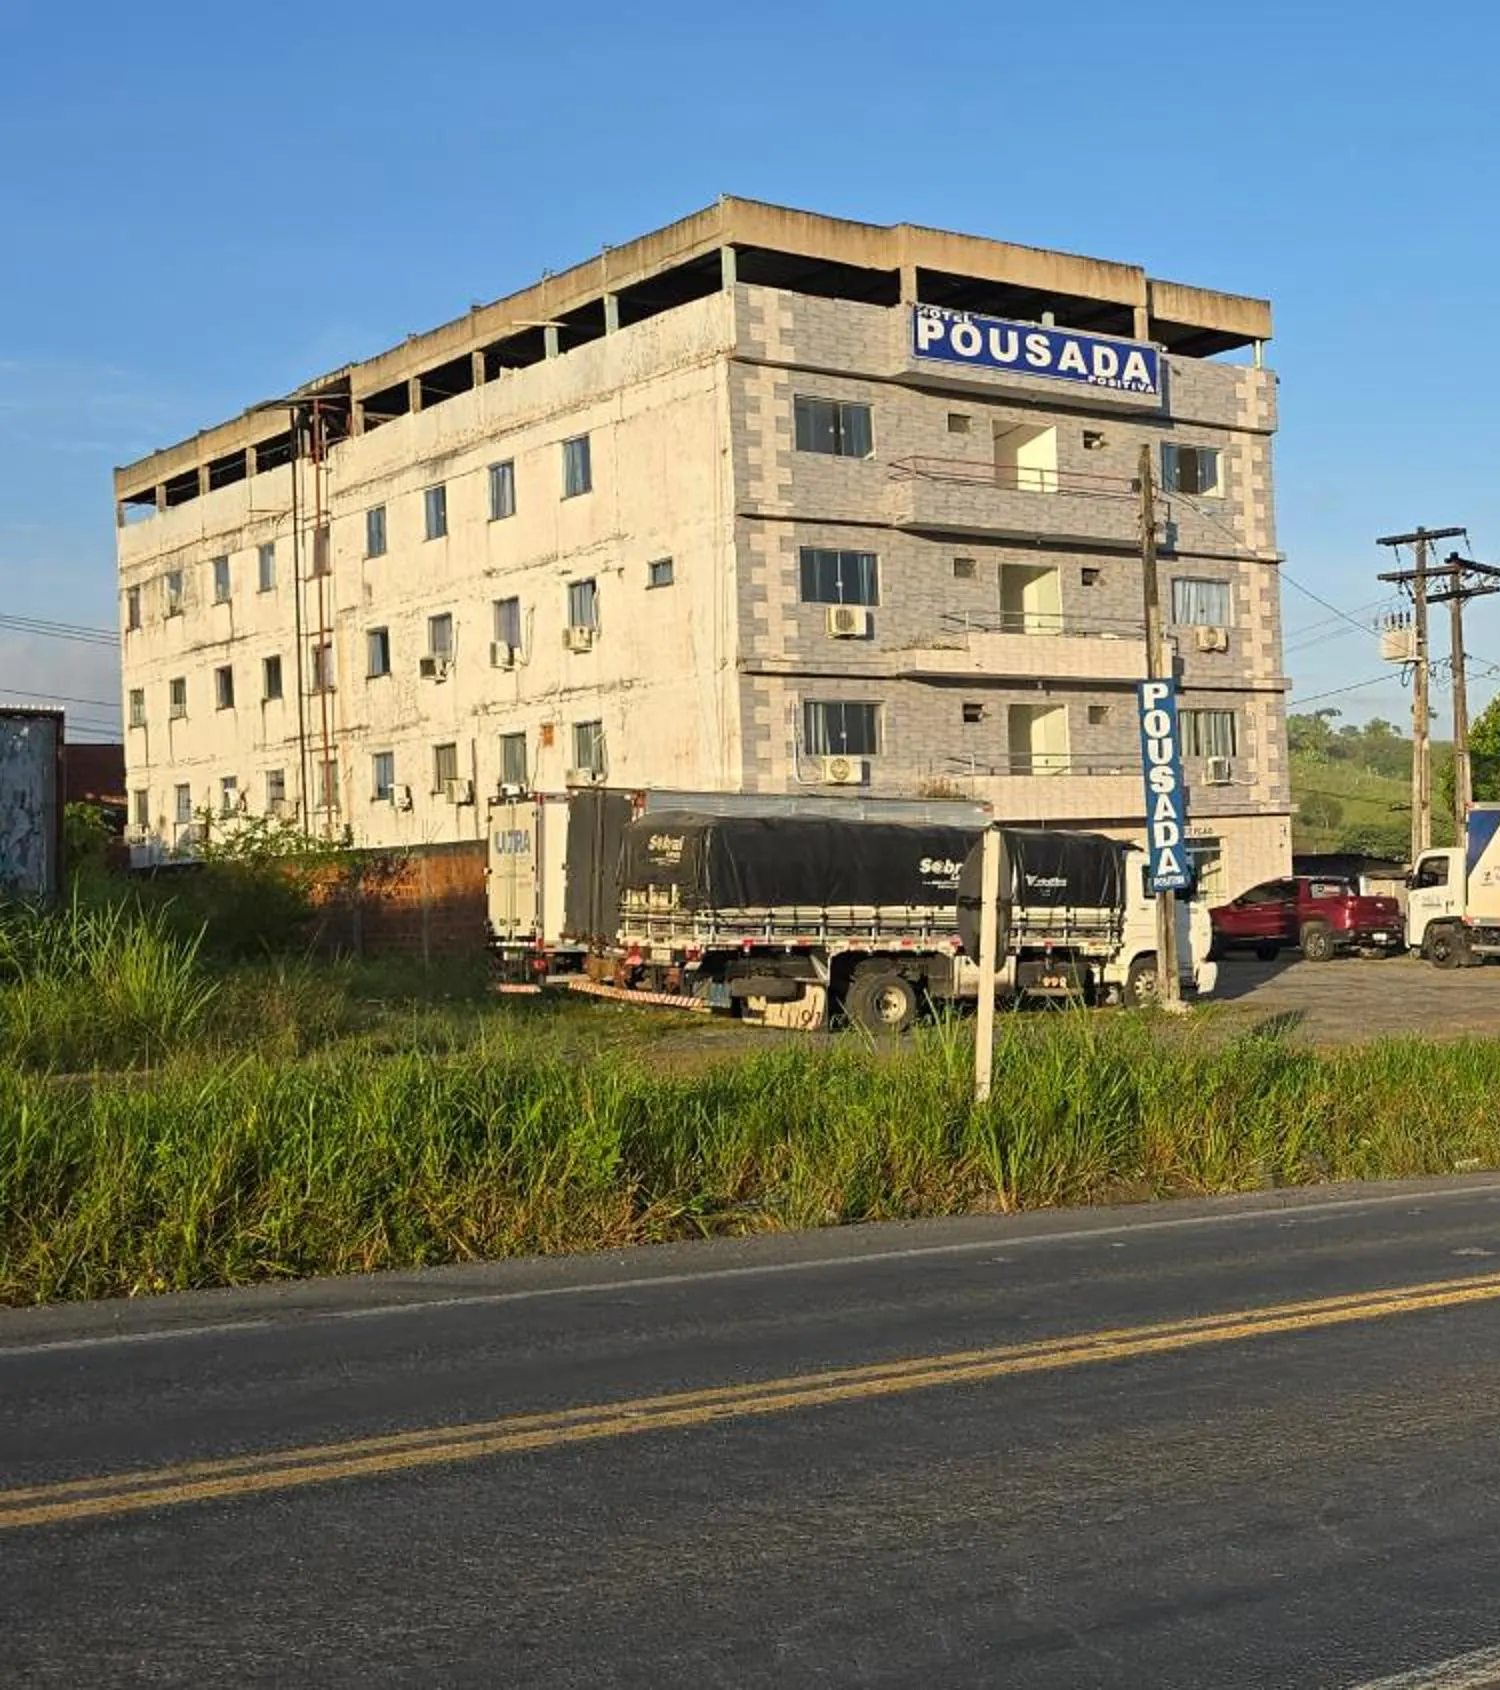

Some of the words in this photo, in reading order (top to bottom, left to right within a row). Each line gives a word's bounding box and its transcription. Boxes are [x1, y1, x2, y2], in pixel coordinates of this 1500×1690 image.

[917, 317, 1151, 384] POUSADA
[1088, 375, 1157, 394] POSITIVA
[1143, 683, 1181, 876] POUSADA
